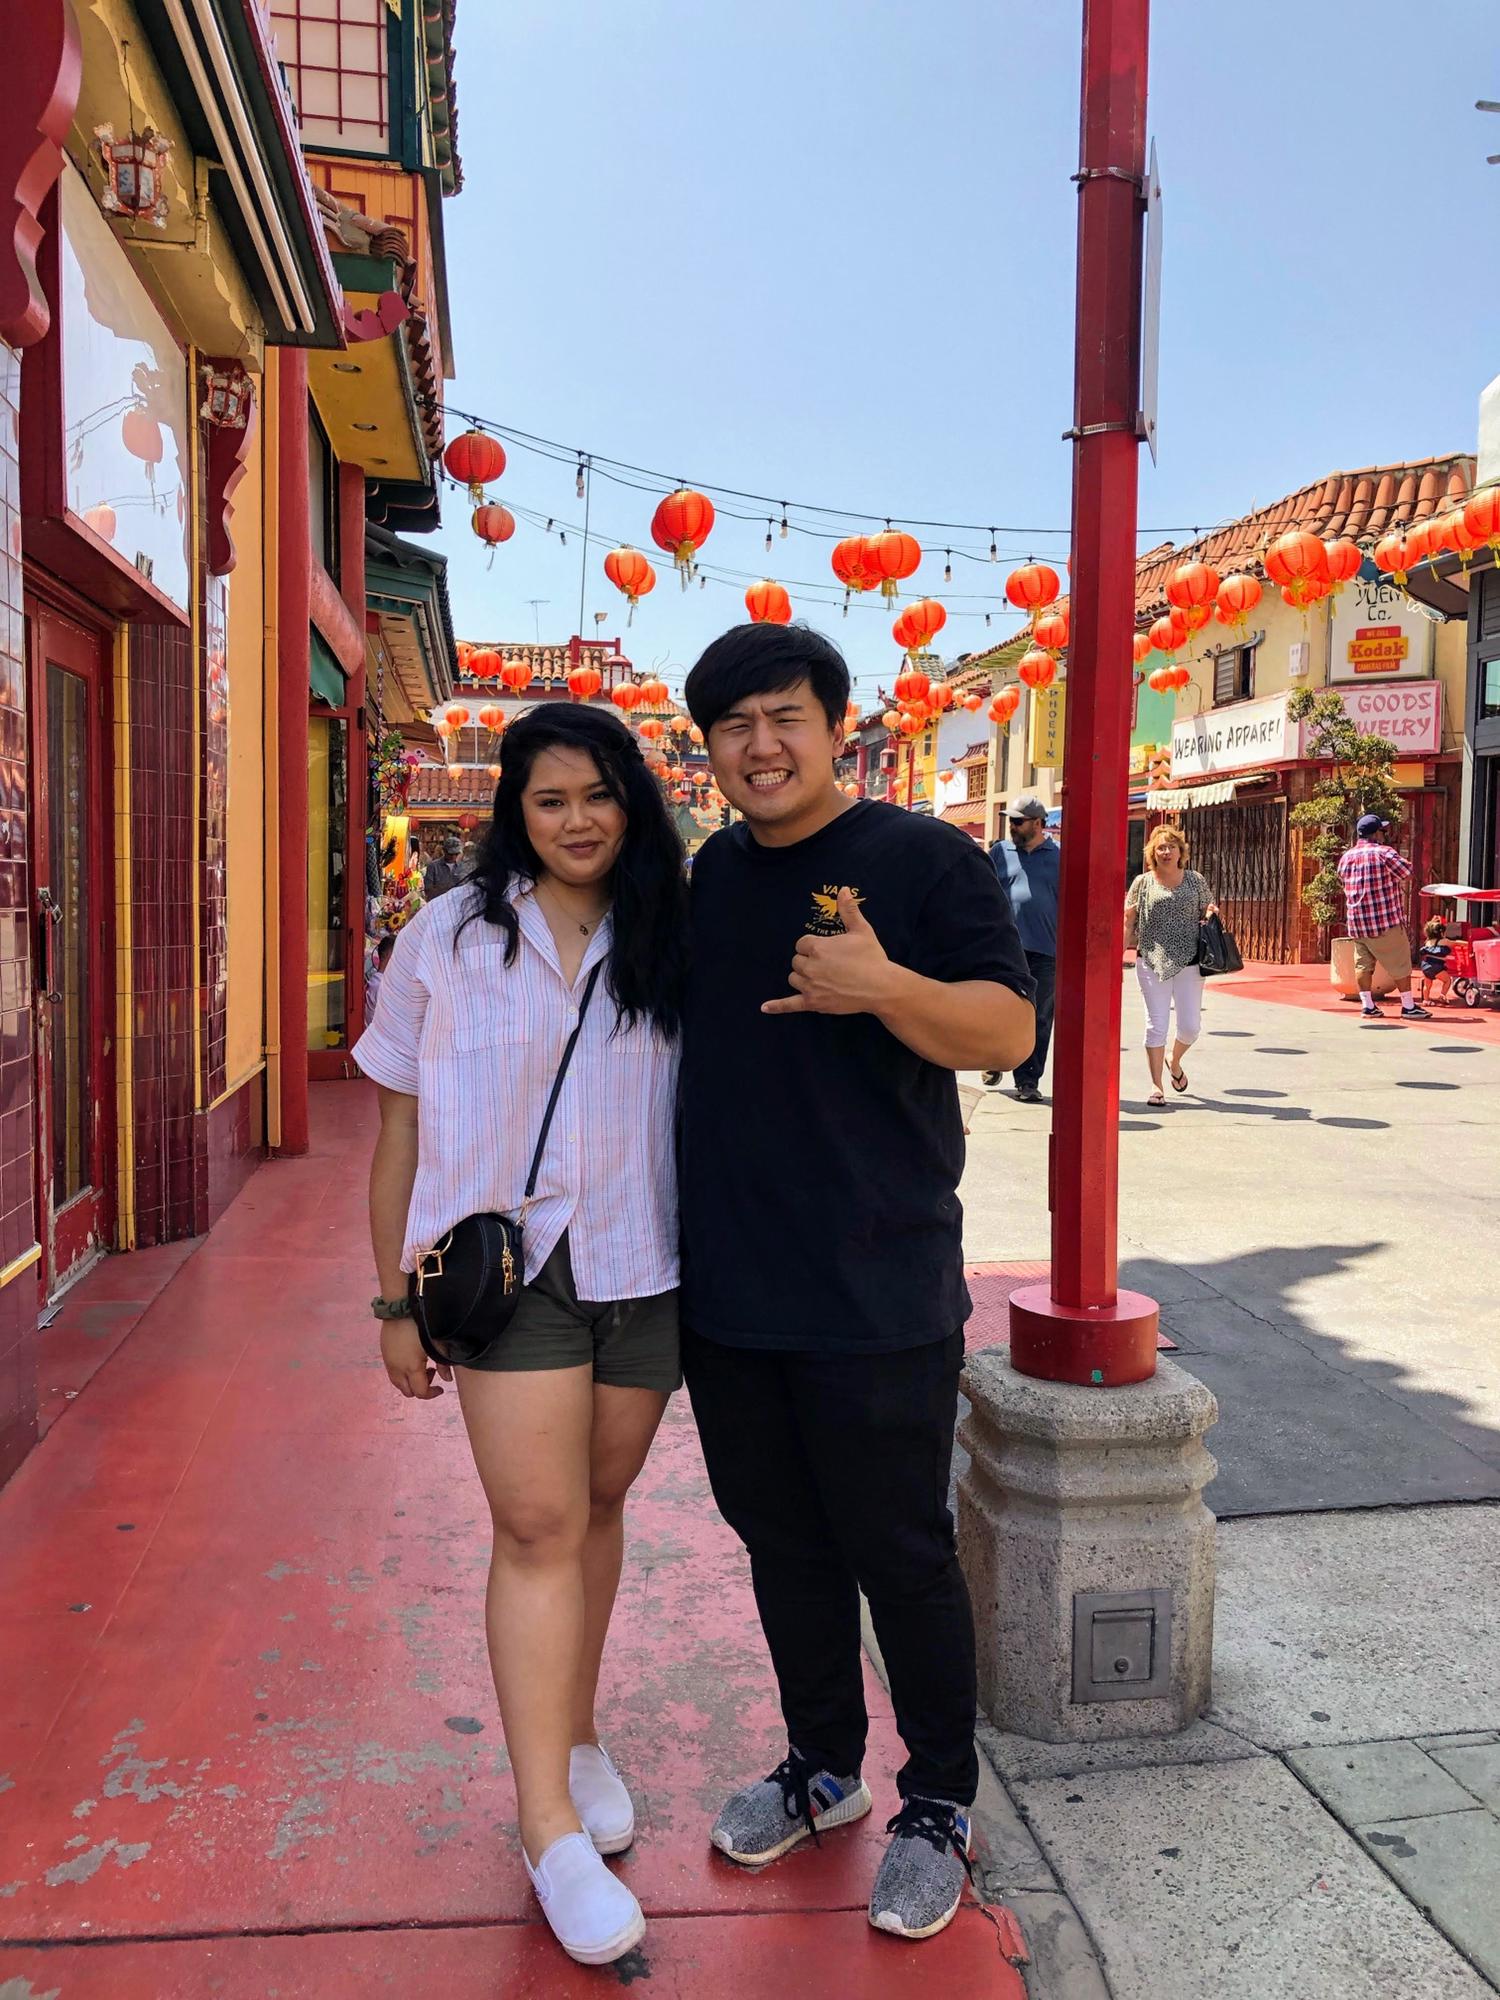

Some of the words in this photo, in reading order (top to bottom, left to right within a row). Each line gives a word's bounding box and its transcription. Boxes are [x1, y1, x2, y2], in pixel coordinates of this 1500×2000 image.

[1367, 605, 1392, 621] Co.
[1350, 641, 1405, 659] Kodak
[1358, 692, 1432, 713] GOODS
[1046, 689, 1059, 759] PHOENIX
[1355, 717, 1432, 738] WELRY
[1174, 731, 1222, 760] WEARING
[823, 884, 860, 897] VAS
